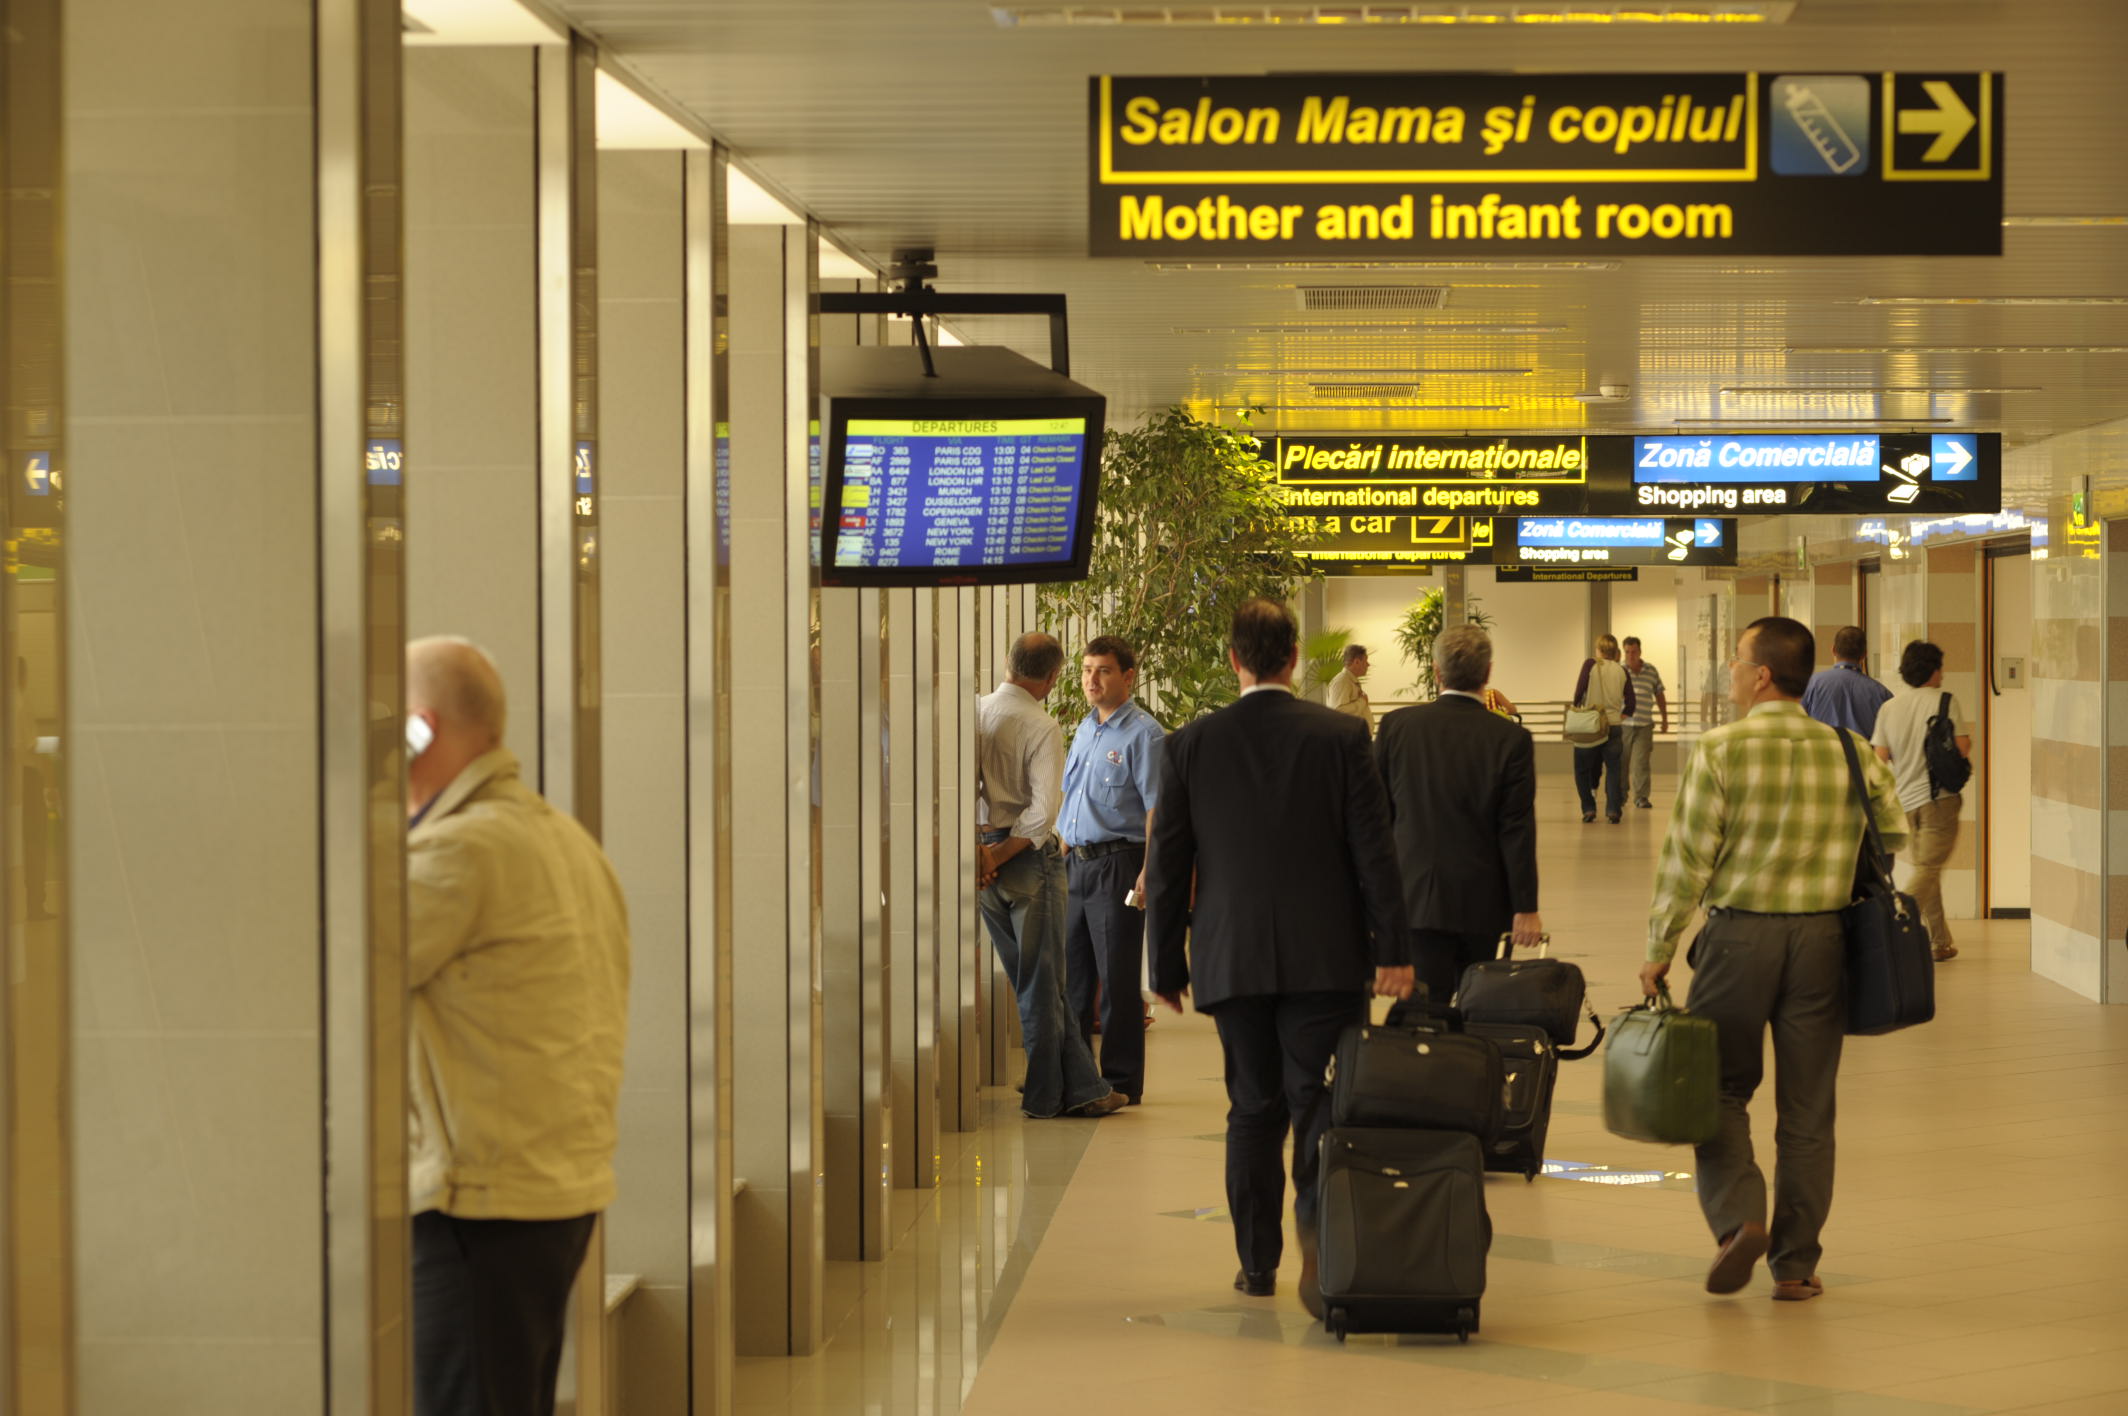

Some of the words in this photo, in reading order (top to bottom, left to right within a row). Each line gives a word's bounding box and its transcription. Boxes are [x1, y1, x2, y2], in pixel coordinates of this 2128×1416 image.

[1120, 97, 1281, 146] Salon
[1295, 96, 1466, 145] Mama
[1548, 95, 1744, 155] copilul
[1119, 194, 1305, 241] Mother
[1315, 193, 1415, 241] and
[1429, 193, 1583, 241] infant
[1595, 203, 1733, 240] room
[912, 420, 998, 433] DEPARTURES
[935, 446, 960, 455] PARIS
[1638, 440, 1712, 468] Zonă
[1718, 440, 1876, 468] Comercială
[934, 456, 960, 465] PARIS
[1283, 443, 1384, 470] Plecări
[928, 466, 966, 476] LONDON
[967, 466, 984, 476] LHR
[927, 476, 965, 486] LONDON
[966, 476, 983, 486] LHR
[938, 487, 973, 496] MUNICH
[925, 497, 983, 506] DUSSELDORF
[1282, 486, 1418, 506] International
[1422, 486, 1540, 510] departures
[1637, 486, 1738, 509] Shopping
[1741, 488, 1787, 505] area
[922, 507, 983, 516] COPENHAGEN
[933, 517, 970, 526] GENEVA
[1350, 515, 1398, 534] car
[926, 528, 949, 537] NEW
[950, 527, 974, 536] YORK
[1567, 521, 1662, 539] Comercială
[925, 538, 948, 546] NEW
[949, 537, 973, 546] YORK
[935, 548, 960, 557] ROME
[1519, 547, 1581, 562] Shopping
[1582, 549, 1609, 560] area
[932, 557, 959, 567] ROME
[1533, 572, 1585, 580] International
[1587, 572, 1632, 581] Departures
